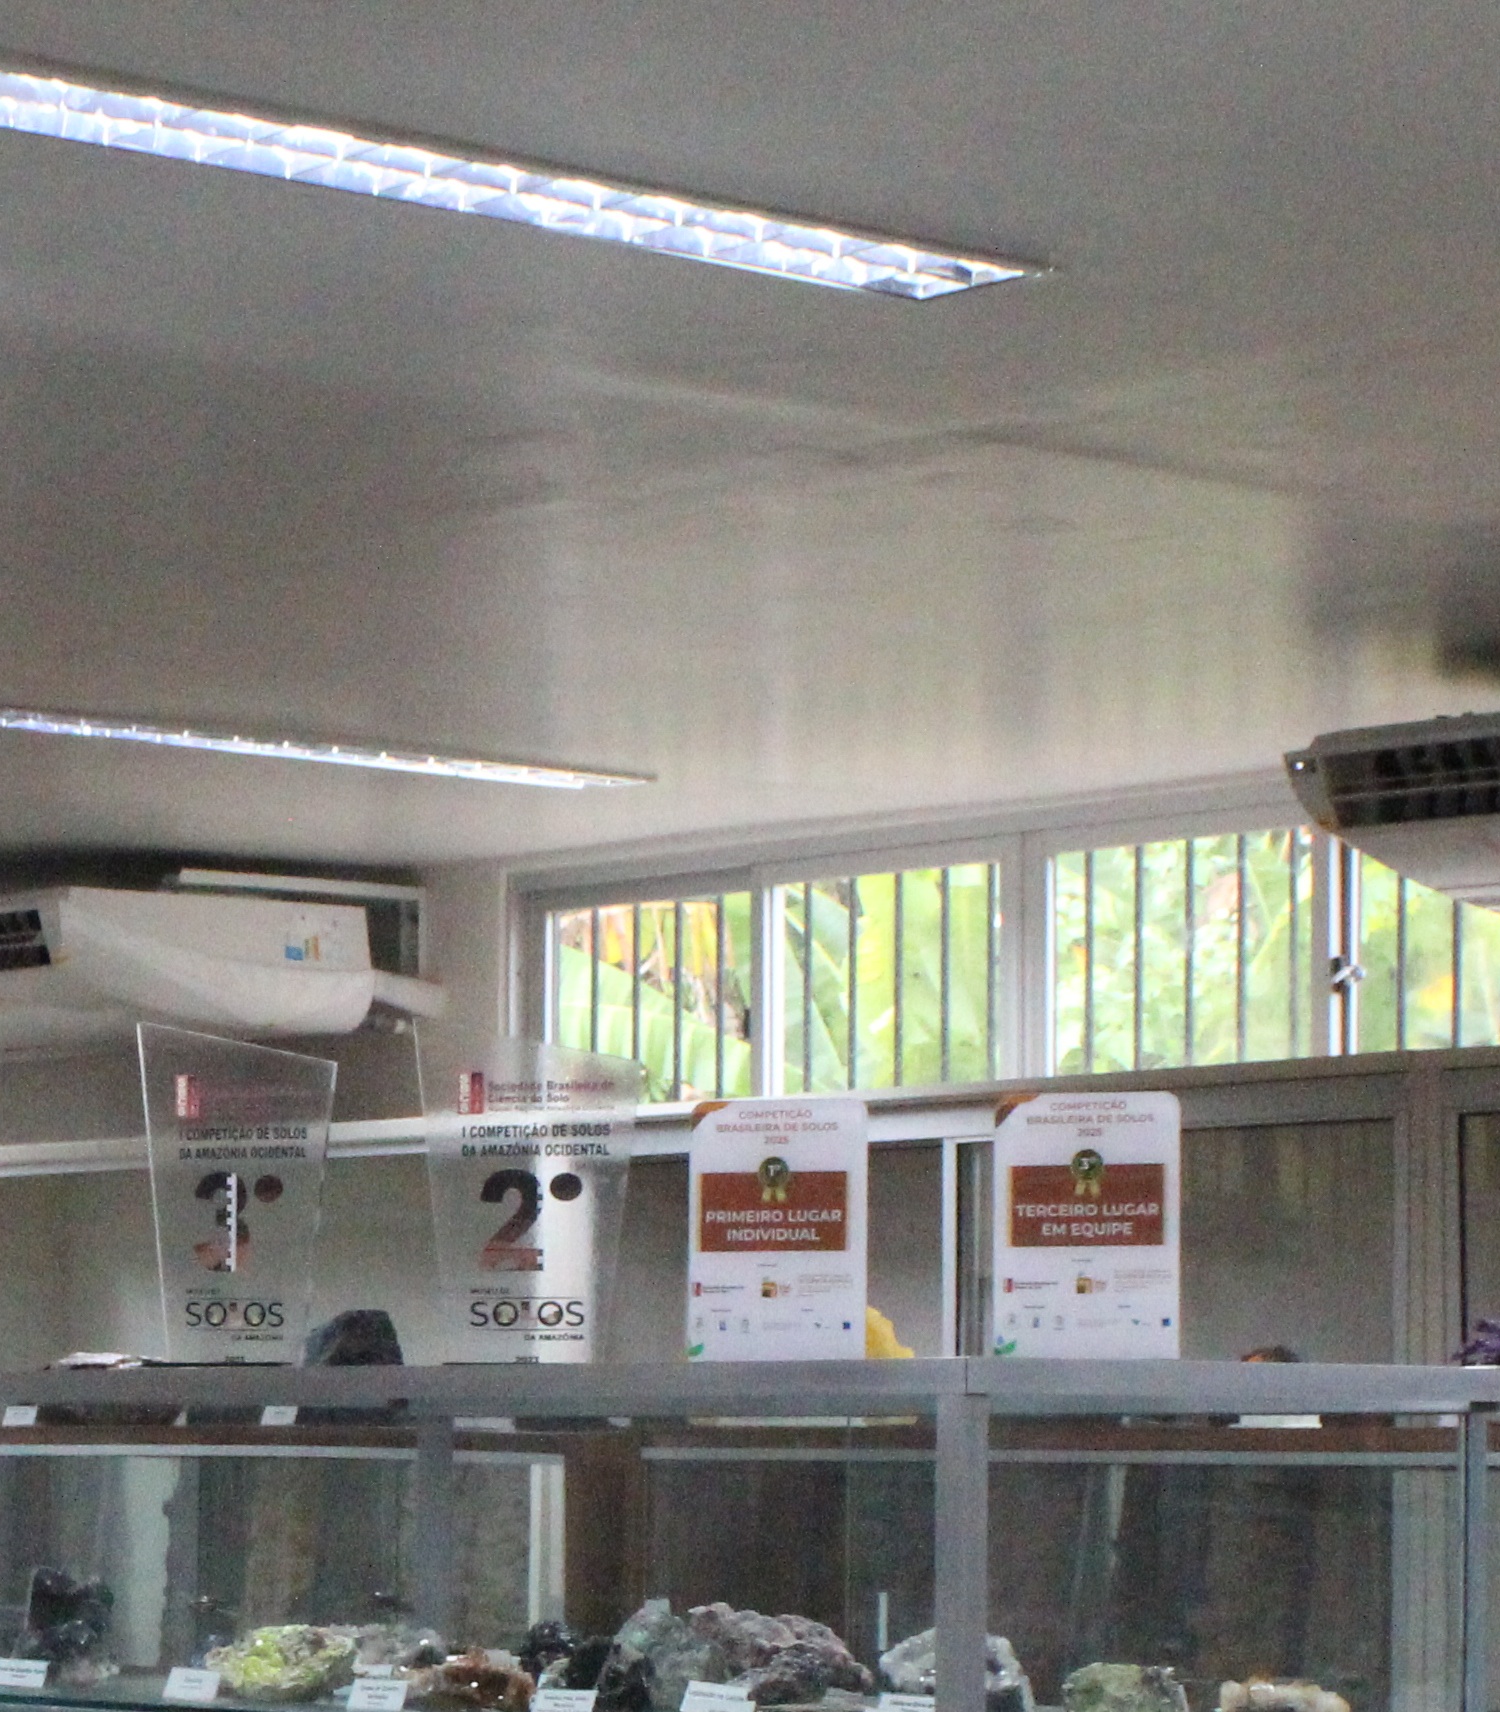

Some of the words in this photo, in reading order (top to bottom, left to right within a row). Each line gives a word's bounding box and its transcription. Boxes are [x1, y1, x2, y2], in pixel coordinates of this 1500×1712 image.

[1050, 1100, 1127, 1111] COMPETIÇÃO
[738, 1109, 813, 1120] COMPETIÇÃO
[1026, 1115, 1094, 1125] BRASILEIRA
[1097, 1114, 1113, 1124] DE
[1117, 1113, 1154, 1123] SOLOS
[186, 1125, 253, 1142] COMPETIÇÃO
[256, 1127, 269, 1140] DE
[273, 1127, 307, 1140] SOLOS
[470, 1122, 548, 1140] COMPETIÇÃO
[552, 1124, 567, 1137] DE
[571, 1123, 611, 1137] SOLOS
[716, 1123, 780, 1133] BRASILEIRA
[784, 1123, 798, 1132] DE
[802, 1122, 838, 1131] SOLOS
[179, 1148, 191, 1160] DA
[195, 1145, 248, 1160] AMAZÔNIA
[250, 1145, 306, 1159] OCIDENTAL
[462, 1145, 477, 1157] DA
[480, 1141, 540, 1157] AMAZÔNIA
[545, 1143, 610, 1156] OCIDENTAL
[706, 1209, 784, 1223] PRIMEIRO
[788, 1209, 842, 1222] LUGAR
[1016, 1203, 1098, 1217] TERCEIRO
[1102, 1203, 1160, 1216] LUGAR
[727, 1227, 820, 1242] INDIVIDUAL
[1041, 1223, 1066, 1236] EM
[1070, 1222, 1133, 1237] EQUIPE
